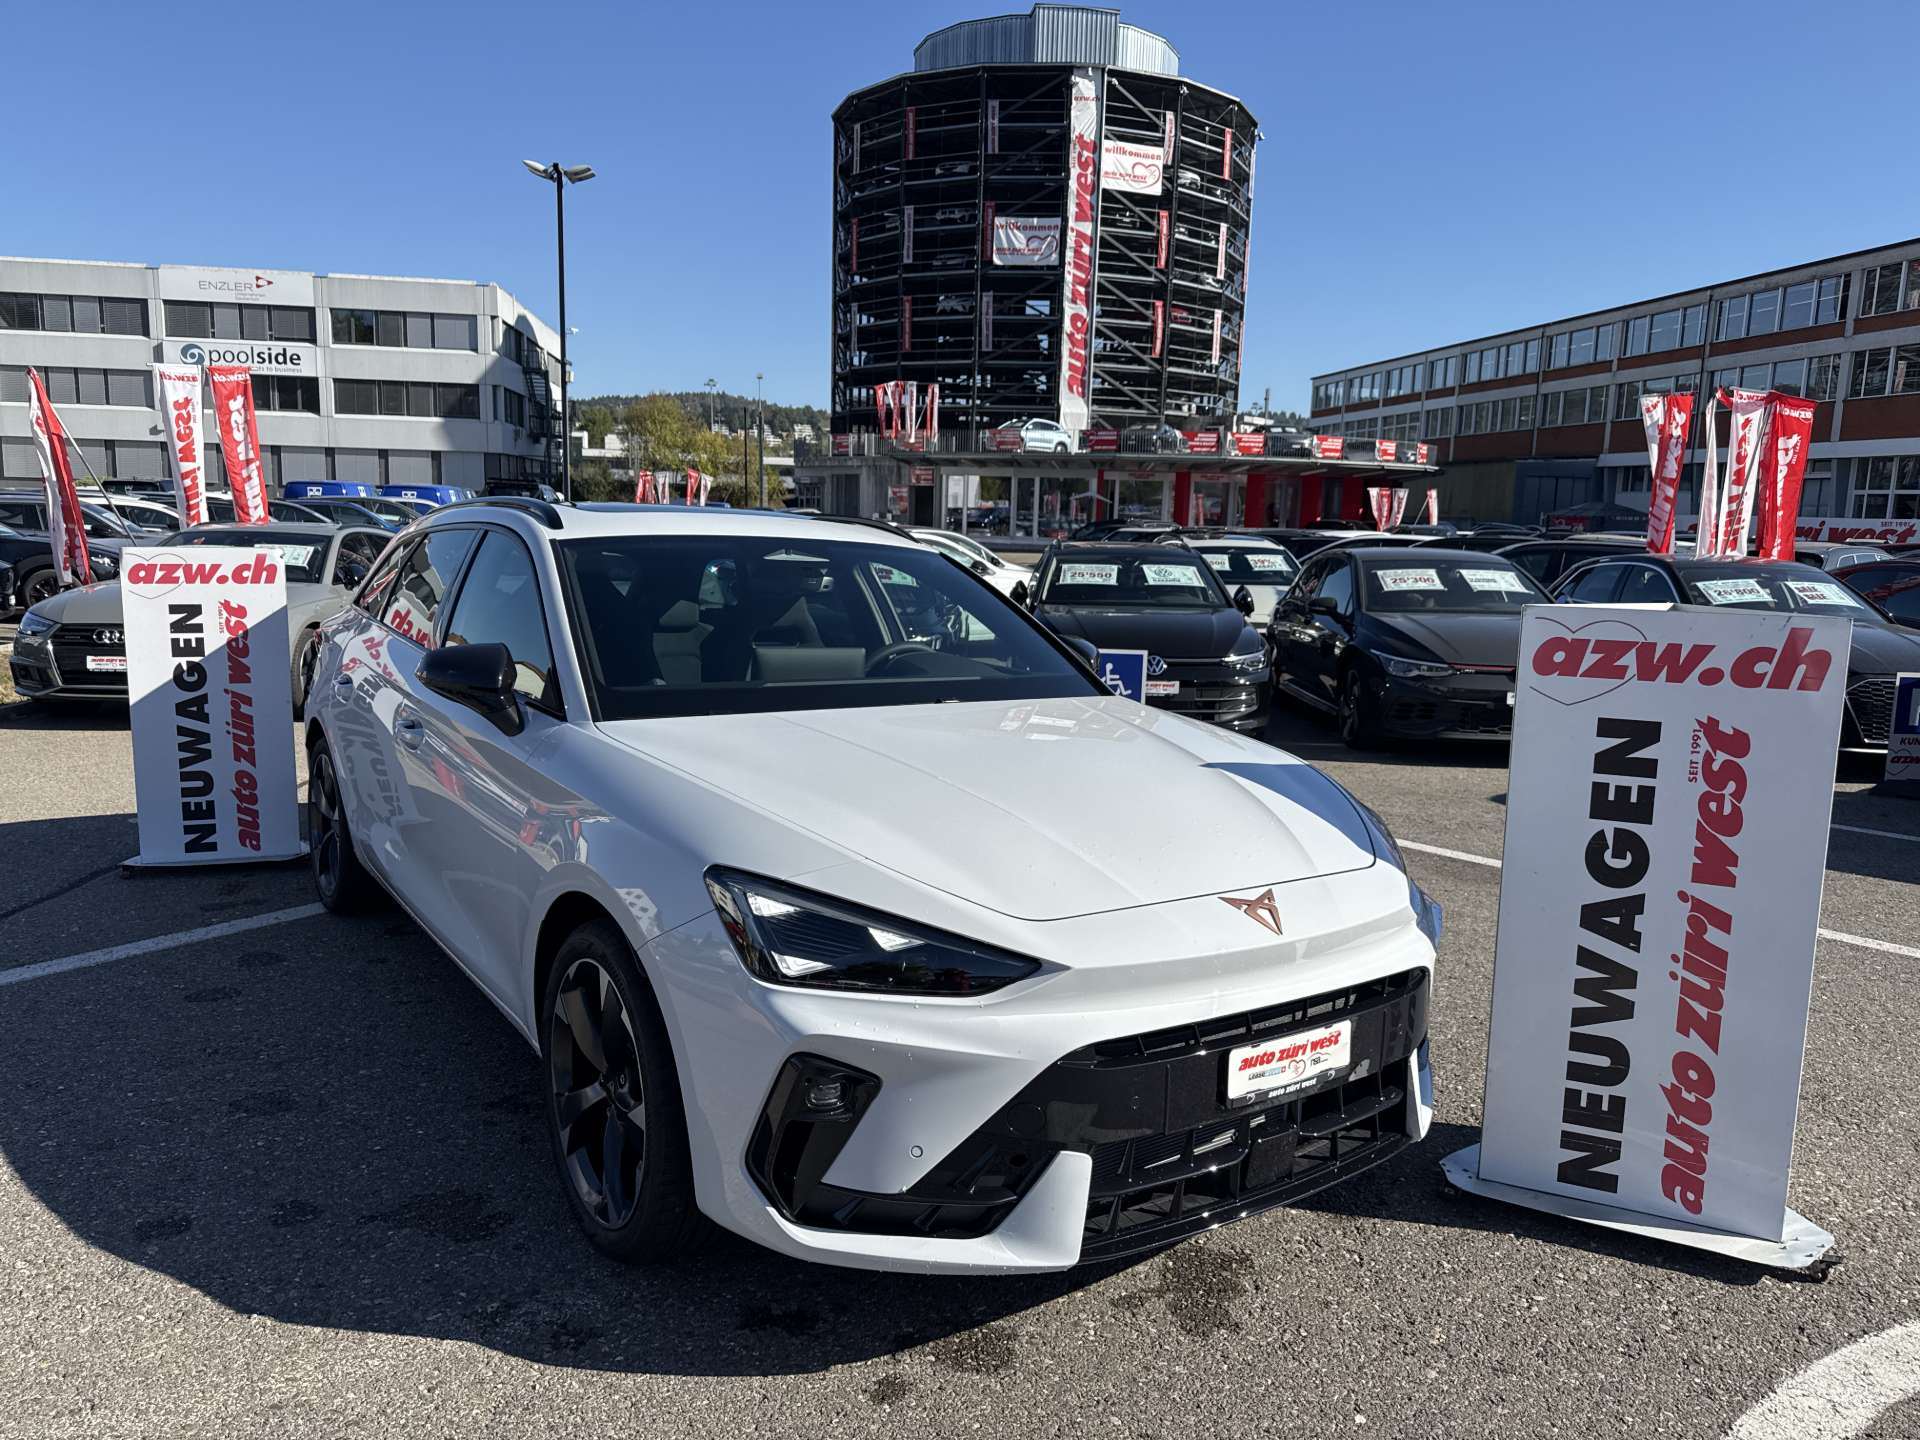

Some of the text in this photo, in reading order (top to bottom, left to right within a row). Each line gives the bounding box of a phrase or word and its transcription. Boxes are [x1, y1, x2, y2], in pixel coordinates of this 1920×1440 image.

[1074, 132, 1098, 222] west
[1105, 145, 1162, 160] willkommen
[199, 280, 254, 292] ENZLER
[209, 346, 302, 366] poolside
[1066, 313, 1088, 398] auto
[128, 553, 277, 585] azw.ch
[1532, 627, 1831, 691] azw.ch
[168, 603, 218, 854] NEUWAGEN
[218, 599, 261, 852] auto züri west
[1688, 729, 1702, 783] SEIT 1991
[1557, 716, 1662, 1194] NEUWAGEN
[1658, 715, 1751, 1216] auto züri west
[1238, 1030, 1342, 1071] auto züri west
[1268, 1078, 1317, 1098] auto züri west
